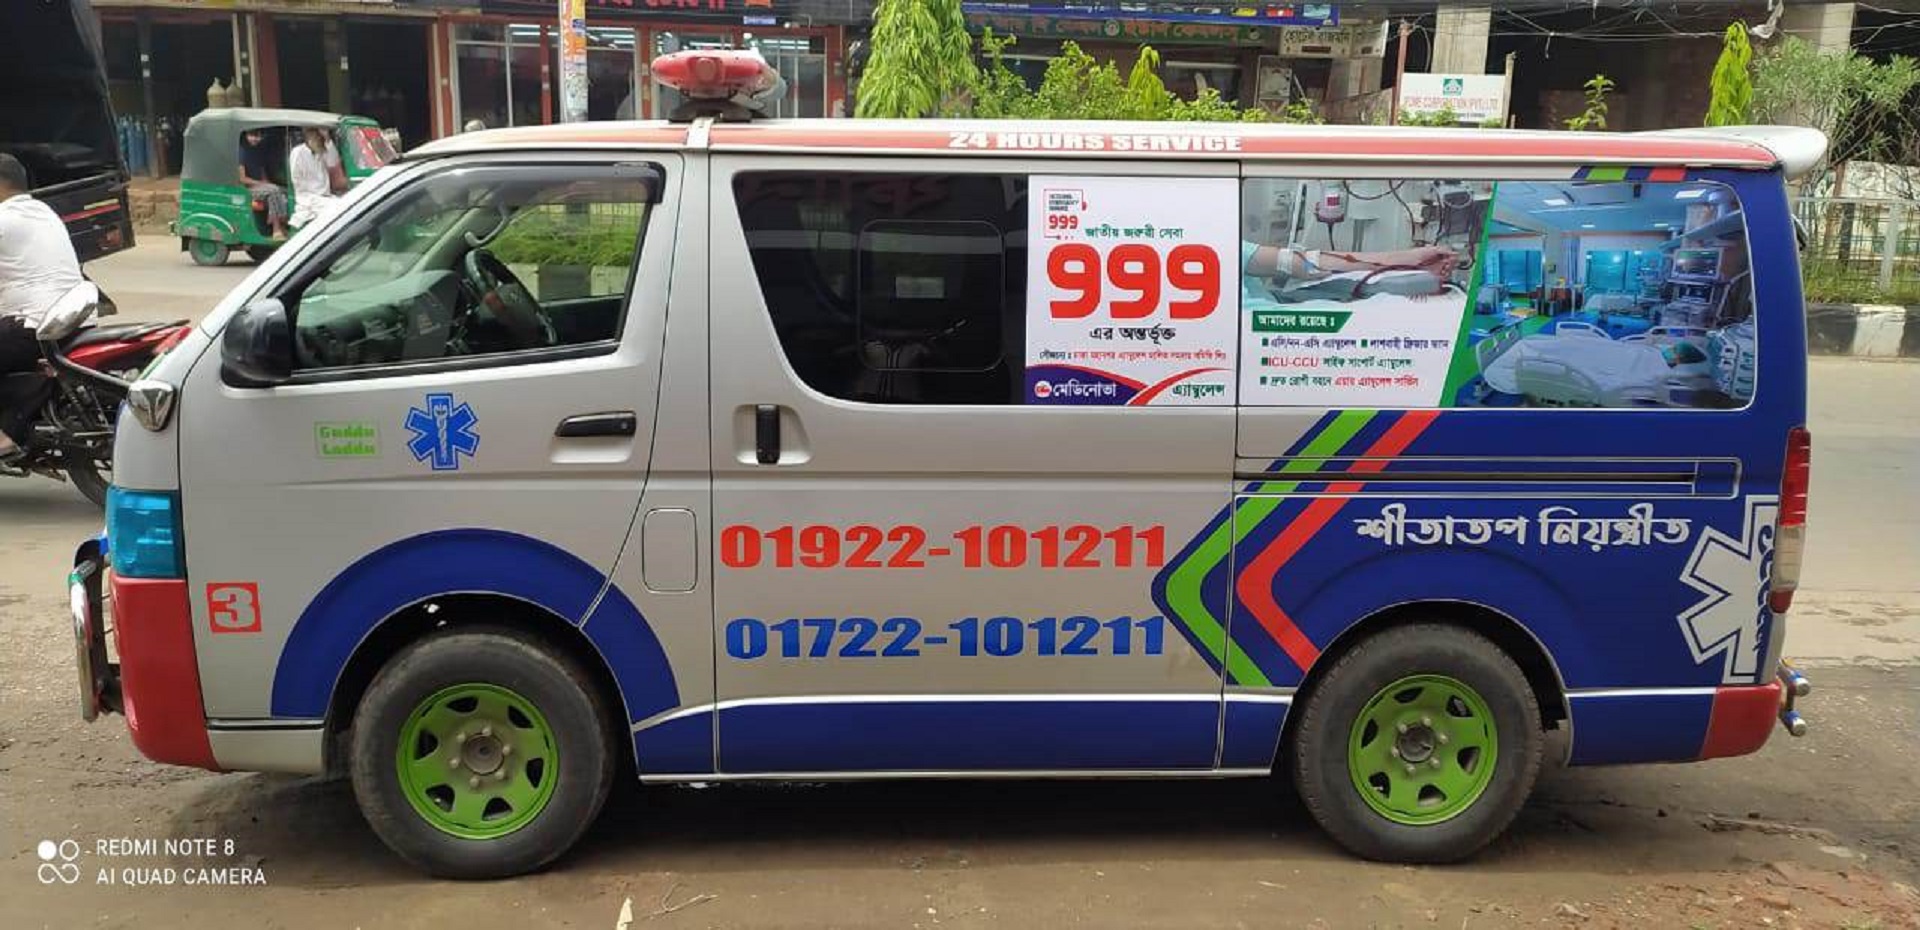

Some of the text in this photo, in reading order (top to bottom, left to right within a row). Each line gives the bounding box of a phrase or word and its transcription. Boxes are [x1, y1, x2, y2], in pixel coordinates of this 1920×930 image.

[948, 132, 1241, 153] 24 HOURS SERVICE
[1048, 214, 1078, 229] 999
[1085, 223, 1119, 239] জাতীয়
[1159, 227, 1184, 239] সেবা
[1046, 243, 1221, 320] 999
[1089, 327, 1113, 341] এর
[1268, 357, 1319, 368] ICU-CCU
[1053, 378, 1117, 398] মেডিনোভা
[1354, 502, 1693, 552] শীতাতপ নিয়ন্ত্রীত
[720, 524, 1165, 568] 01922-101211
[212, 586, 257, 631] 3
[725, 615, 1165, 659] 01722-101211
